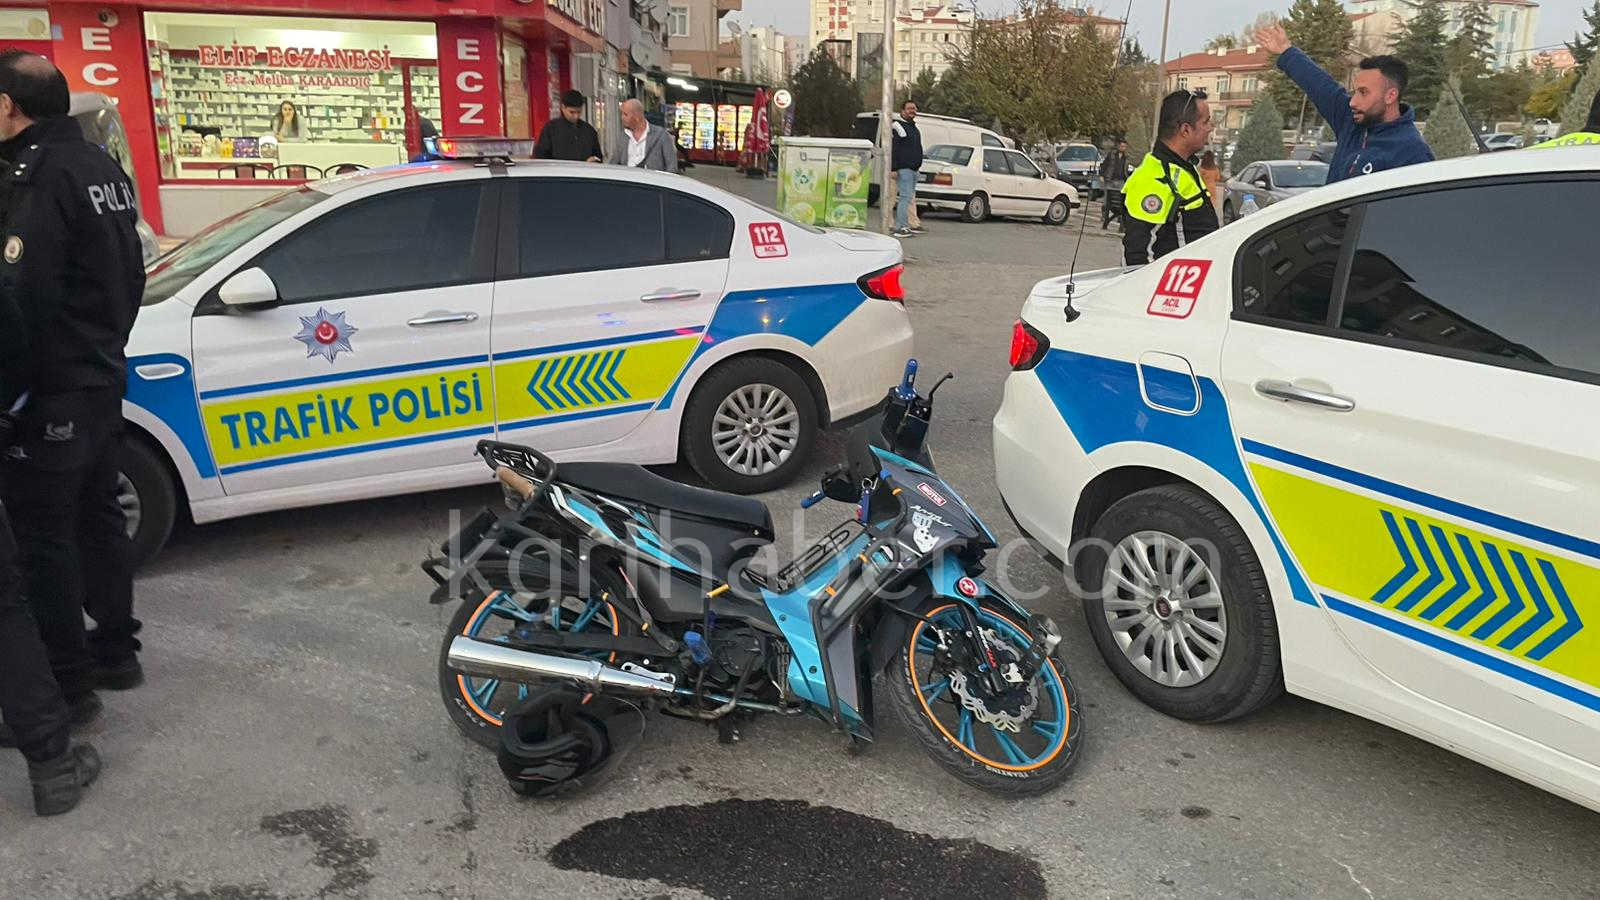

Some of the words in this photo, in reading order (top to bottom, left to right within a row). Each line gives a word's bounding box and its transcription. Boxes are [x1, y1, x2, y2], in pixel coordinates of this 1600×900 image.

[198, 40, 258, 67] ELİF
[265, 44, 393, 71] ECZANESİ
[754, 225, 782, 244] 112
[1164, 264, 1202, 294] 112
[220, 394, 359, 449] TRAFİK
[369, 372, 484, 427] POLİSİ
